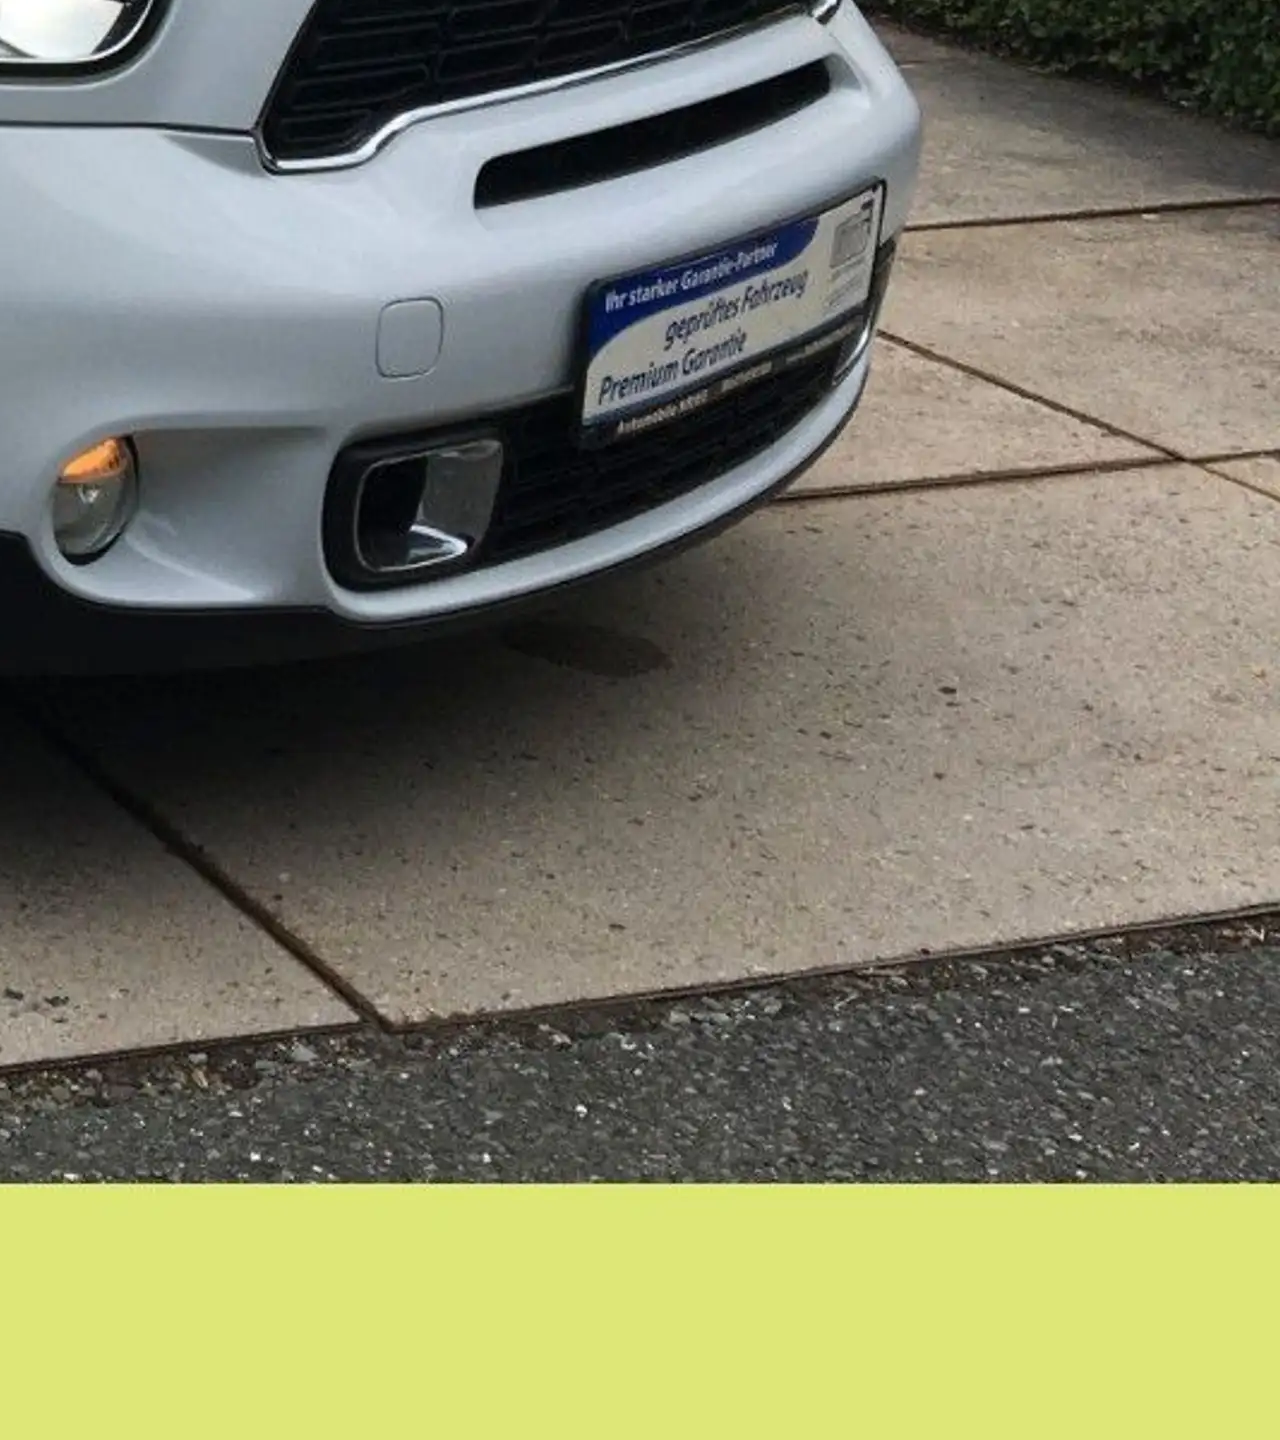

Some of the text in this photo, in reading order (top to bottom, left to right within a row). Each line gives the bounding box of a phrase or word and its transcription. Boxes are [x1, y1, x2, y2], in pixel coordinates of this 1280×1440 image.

[605, 288, 627, 313] Ihr
[628, 277, 679, 307] starker
[598, 361, 680, 405] Premium
[681, 328, 748, 375] Garantie
